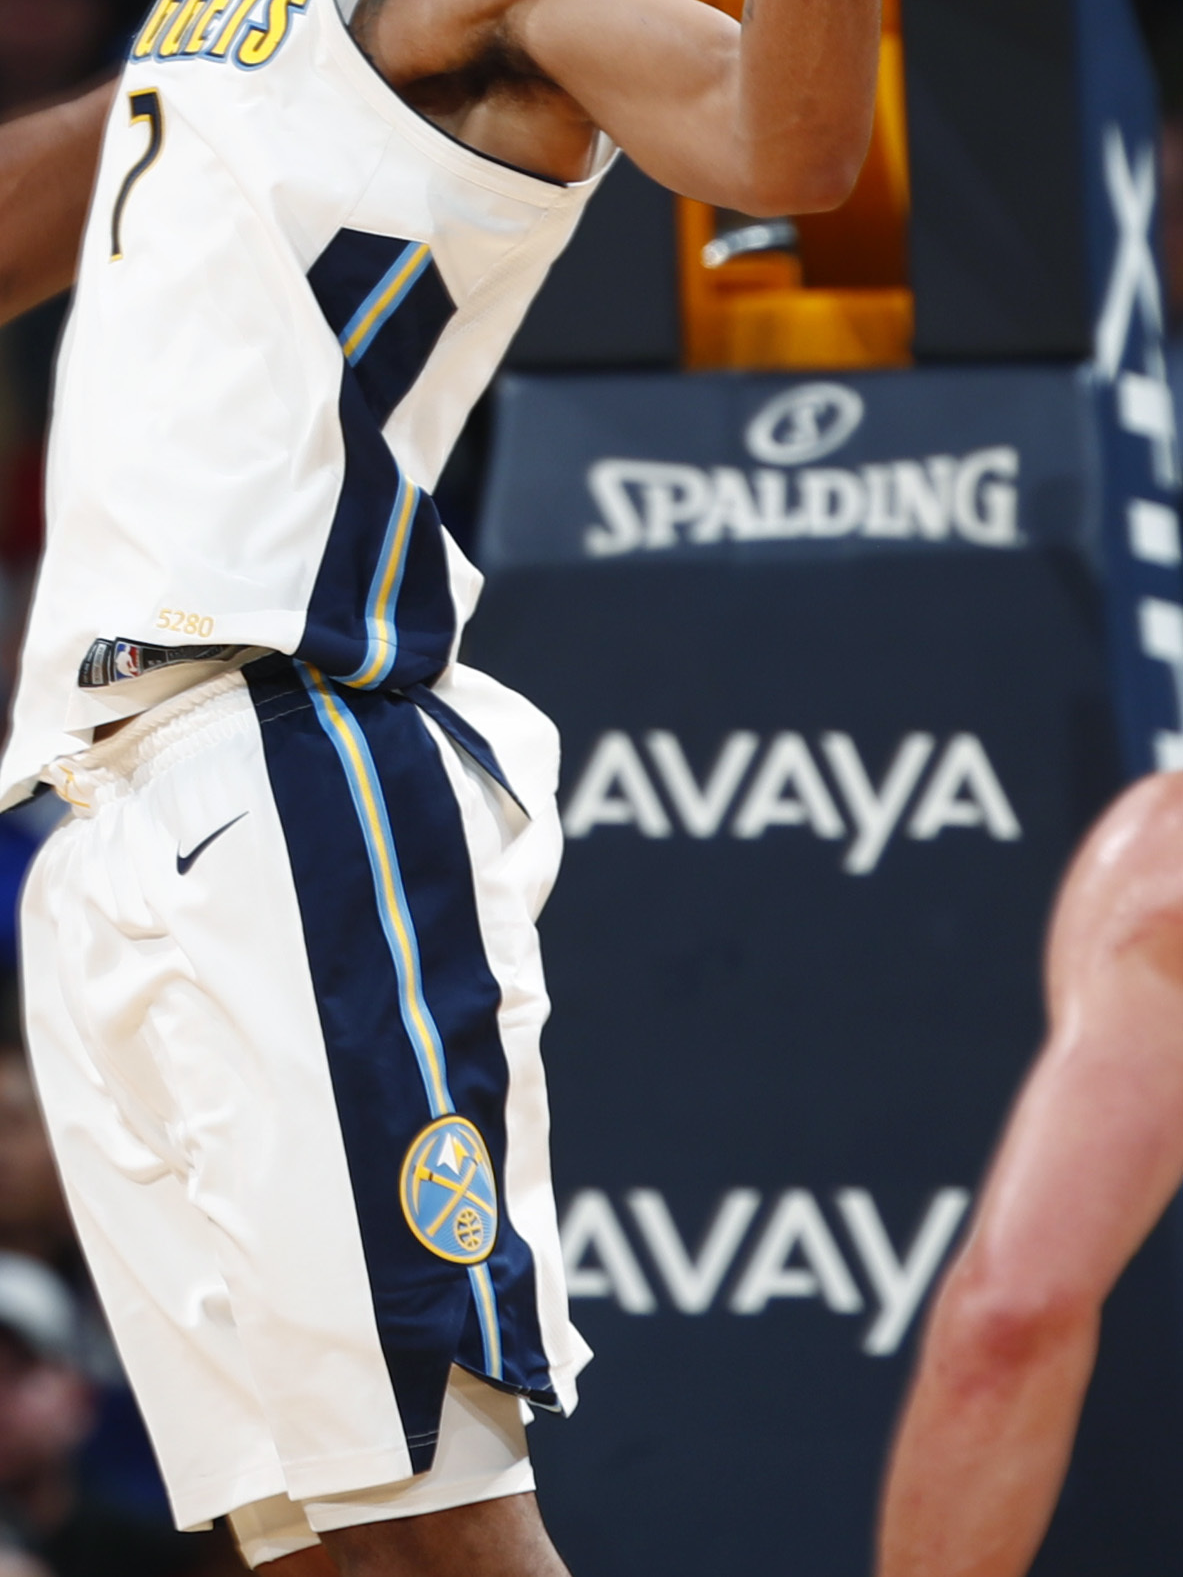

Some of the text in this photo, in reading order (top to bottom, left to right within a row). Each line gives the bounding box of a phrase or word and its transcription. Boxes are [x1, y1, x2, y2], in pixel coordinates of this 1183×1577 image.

[109, 86, 164, 262] 7
[583, 445, 1024, 558] SPALDING
[156, 607, 215, 639] 5280
[562, 1186, 971, 1358] AVAY
